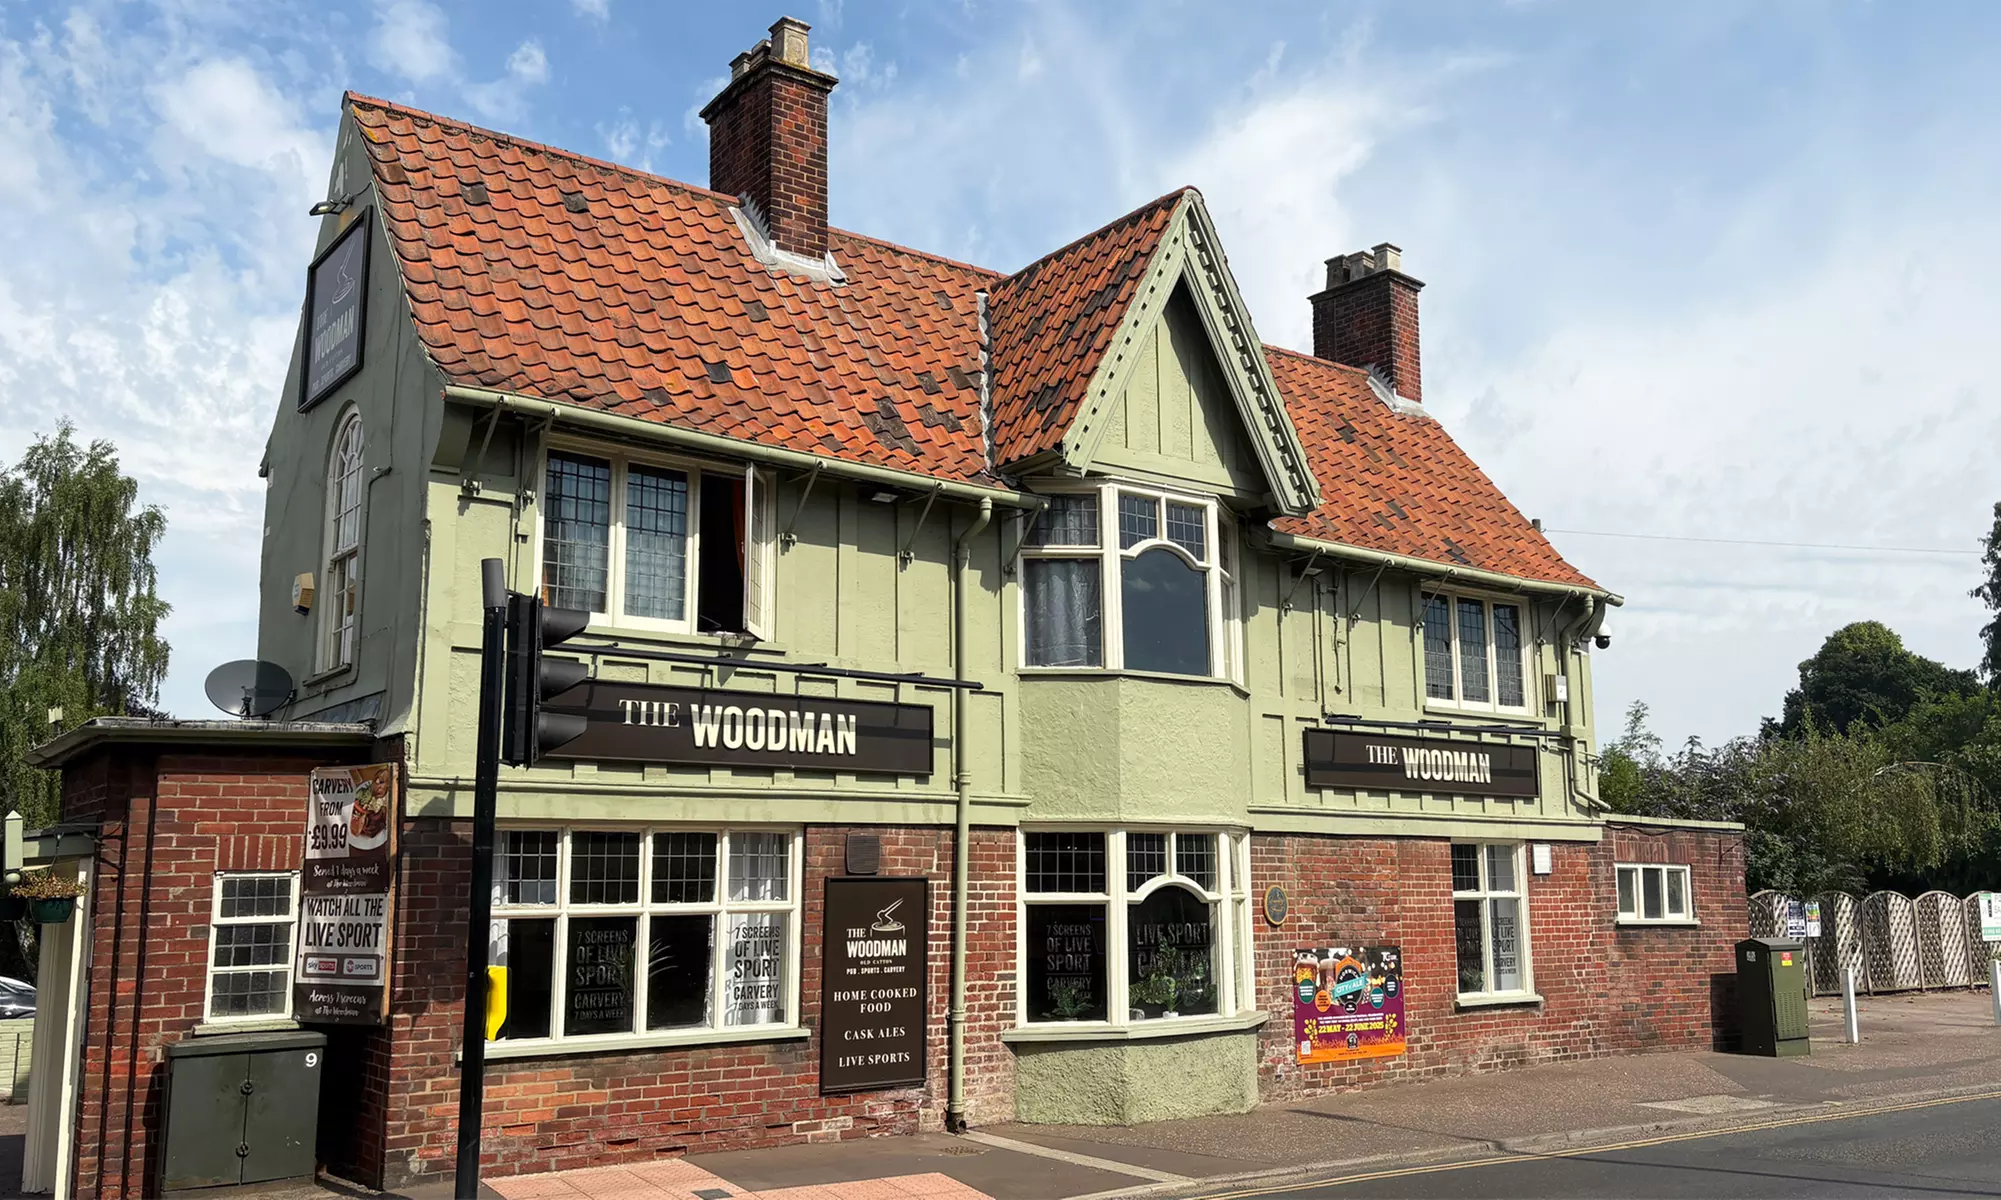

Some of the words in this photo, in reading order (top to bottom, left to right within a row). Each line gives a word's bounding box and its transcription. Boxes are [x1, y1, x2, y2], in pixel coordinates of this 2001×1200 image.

[314, 305, 354, 364] WOODMAN
[619, 699, 680, 728] THE
[690, 703, 856, 756] WOODMAN
[1366, 744, 1398, 765] THE
[1402, 747, 1492, 784] WOODMAN
[312, 778, 354, 795] CARVERY
[320, 801, 344, 817] FROM
[311, 822, 348, 850] £9.99
[362, 863, 380, 876] week
[307, 898, 341, 917] WATCH
[343, 898, 361, 916] ALL
[364, 898, 383, 916] THE
[305, 922, 335, 947] LIVE
[337, 922, 382, 948] SPORT
[576, 931, 582, 944] 7
[584, 929, 628, 944] SCREENS
[736, 927, 740, 939] 7
[742, 926, 780, 939] SCREENS
[846, 928, 866, 938] THE
[1046, 925, 1051, 936] 7
[1053, 924, 1091, 936] SCREENS
[1136, 924, 1164, 945] LIVE
[1168, 922, 1208, 944] SPORT
[1501, 926, 1514, 938] LIVE
[735, 940, 750, 958] OF
[753, 940, 779, 957] LIVE
[846, 940, 906, 958] WOODMAN
[1047, 937, 1063, 952] OF
[1065, 937, 1091, 952] LIVE
[576, 946, 593, 964] OF
[1047, 954, 1092, 971] SPORT
[308, 961, 318, 971] sky
[318, 961, 336, 971] sports
[734, 959, 779, 978] SPORT
[1047, 977, 1092, 990] CARVERY
[1336, 984, 1349, 993] CITY
[1352, 980, 1362, 988] ALE
[309, 990, 334, 1003] Across
[340, 994, 367, 1004] screens
[734, 984, 779, 1000] CARVERY
[834, 990, 867, 1001] HOME
[870, 988, 917, 999] COOKED
[574, 992, 625, 1009] CARVERY
[738, 1002, 754, 1010] DAYS
[761, 1001, 779, 1009] WEEK
[860, 1002, 891, 1014] FOOD
[580, 1010, 599, 1020] DAYS
[599, 1010, 604, 1019] A
[844, 1029, 874, 1040] CASK
[878, 1027, 905, 1039] ALES
[1318, 1025, 1327, 1033] 22
[305, 1053, 317, 1067] 9
[839, 1055, 864, 1067] LIVE
[868, 1052, 910, 1064] SPORTS
